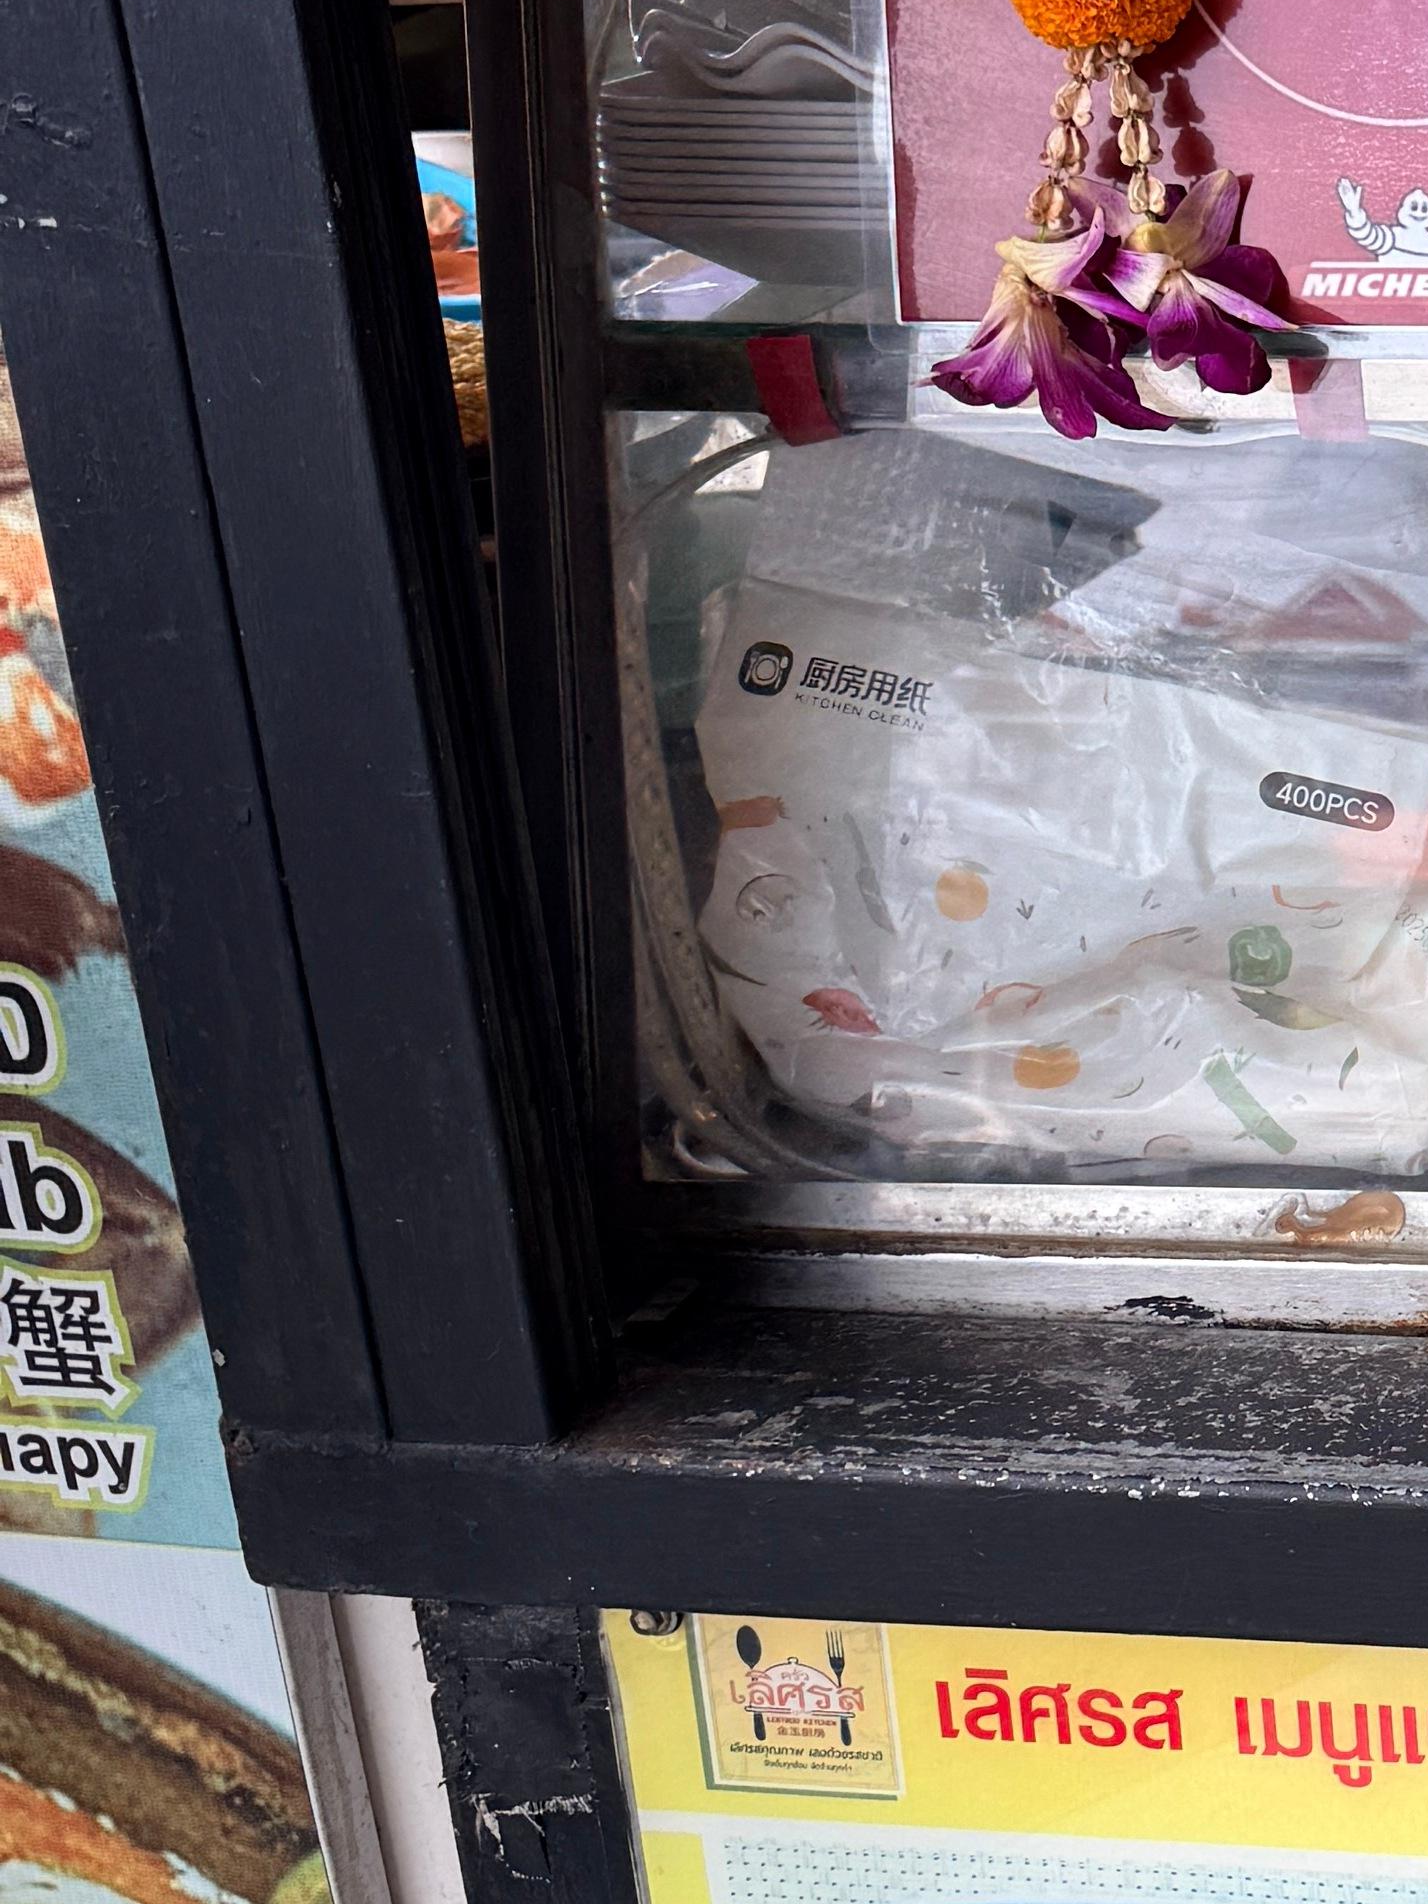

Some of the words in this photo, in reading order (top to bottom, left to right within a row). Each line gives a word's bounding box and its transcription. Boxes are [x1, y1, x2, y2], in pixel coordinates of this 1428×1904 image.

[800, 657, 935, 716] 厨房用纸
[795, 693, 863, 717] KITCHEN
[868, 710, 925, 732] CLEAN
[1275, 782, 1380, 824] 400PCS
[935, 1667, 1184, 1751] เลิศรส
